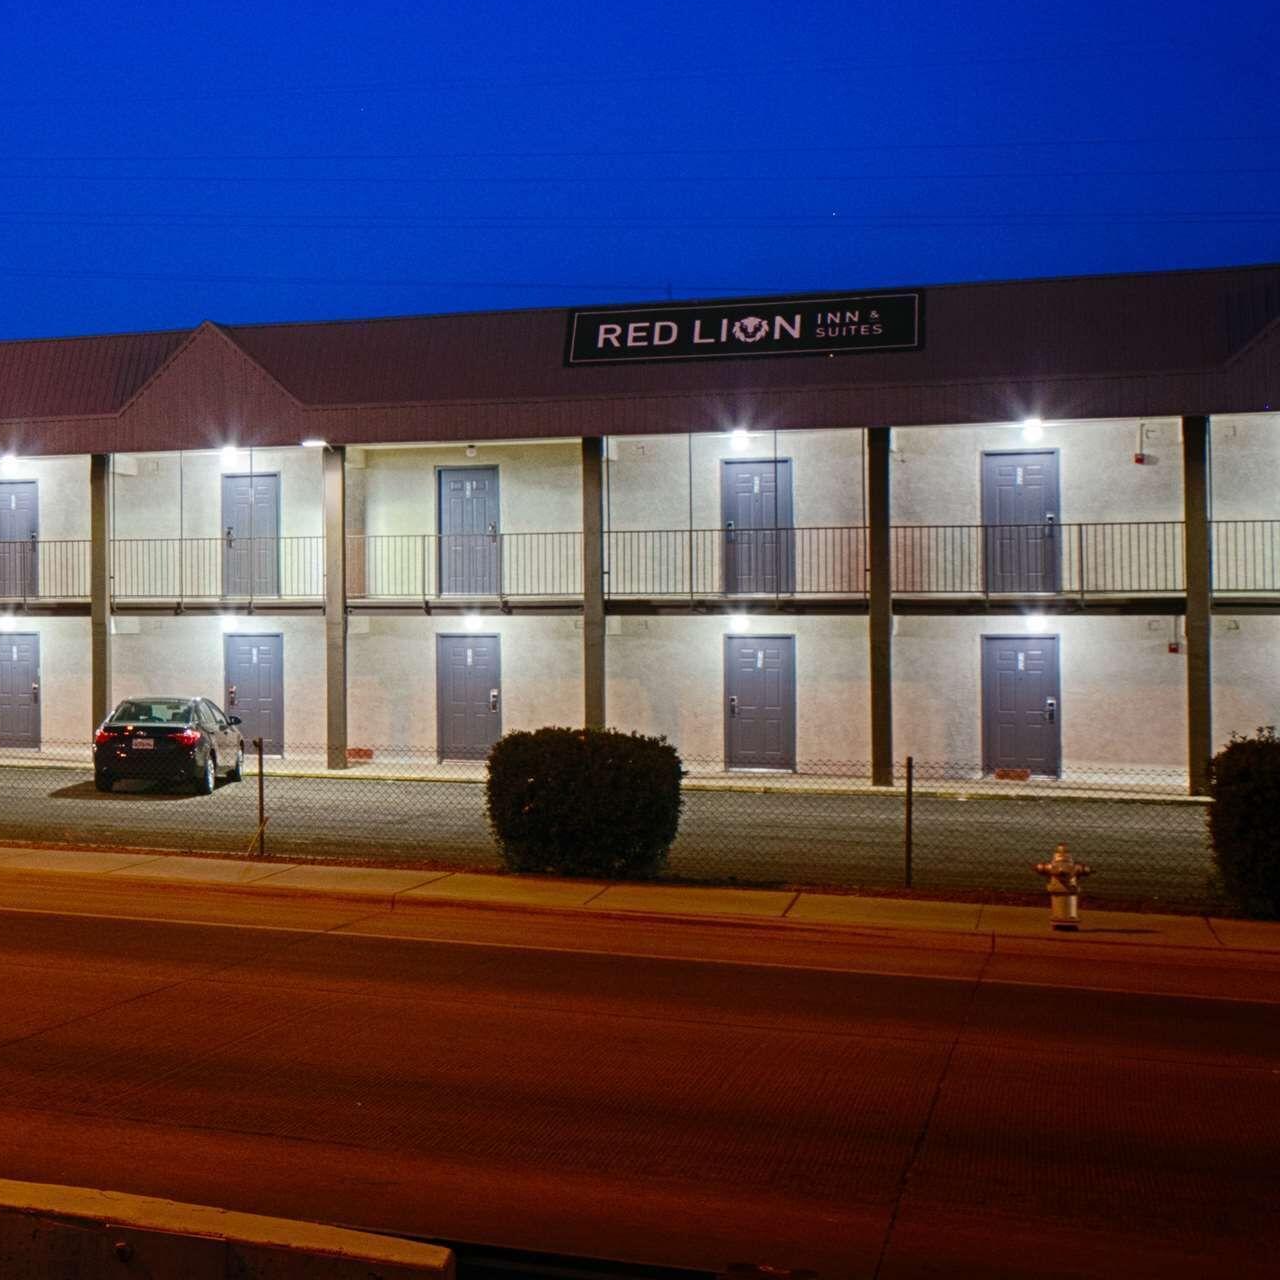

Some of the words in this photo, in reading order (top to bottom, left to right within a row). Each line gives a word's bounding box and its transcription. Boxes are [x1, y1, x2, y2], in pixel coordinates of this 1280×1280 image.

[816, 310, 860, 325] INN
[869, 310, 880, 319] &
[597, 321, 678, 348] RED
[693, 314, 802, 344] LION
[816, 324, 884, 338] SUITES
